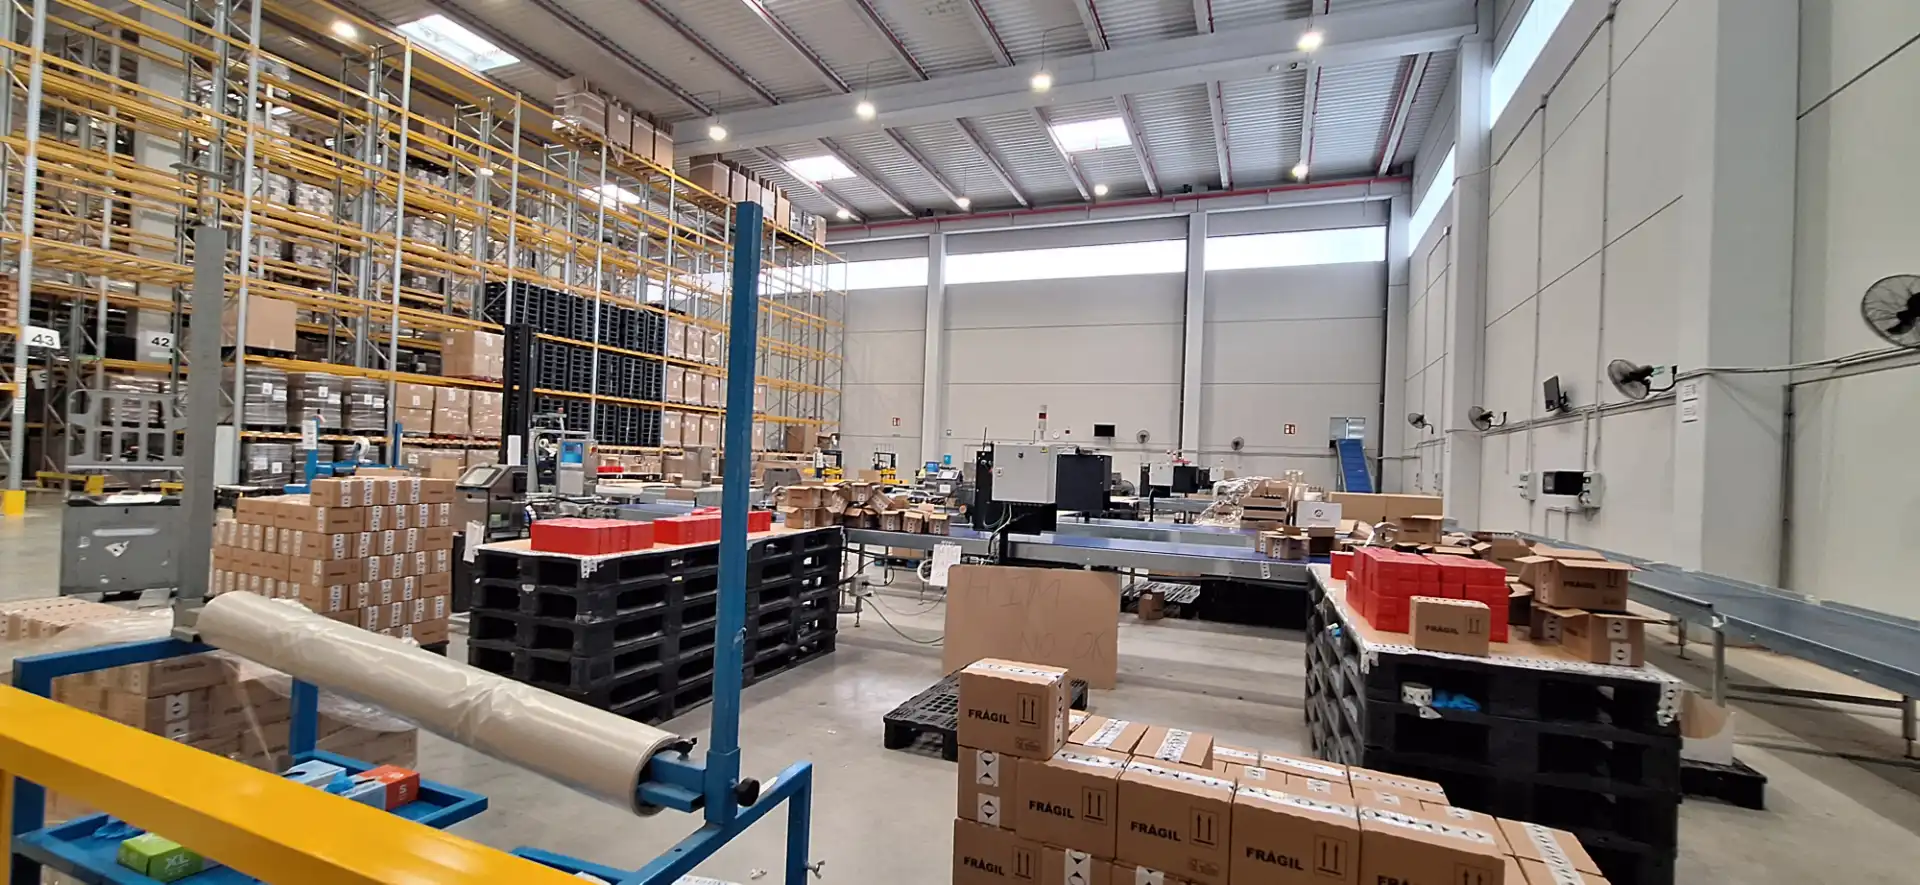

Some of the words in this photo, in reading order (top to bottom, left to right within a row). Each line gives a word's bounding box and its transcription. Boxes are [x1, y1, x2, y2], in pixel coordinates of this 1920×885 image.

[32, 334, 55, 347] 43
[151, 338, 170, 347] 42
[968, 708, 1010, 724] FRÁGIL
[1028, 800, 1075, 819] FRÁGIL
[1130, 821, 1181, 842] FRÁGIL
[963, 856, 1005, 876] FRÁGIL
[1246, 847, 1304, 870] FRÁGIL
